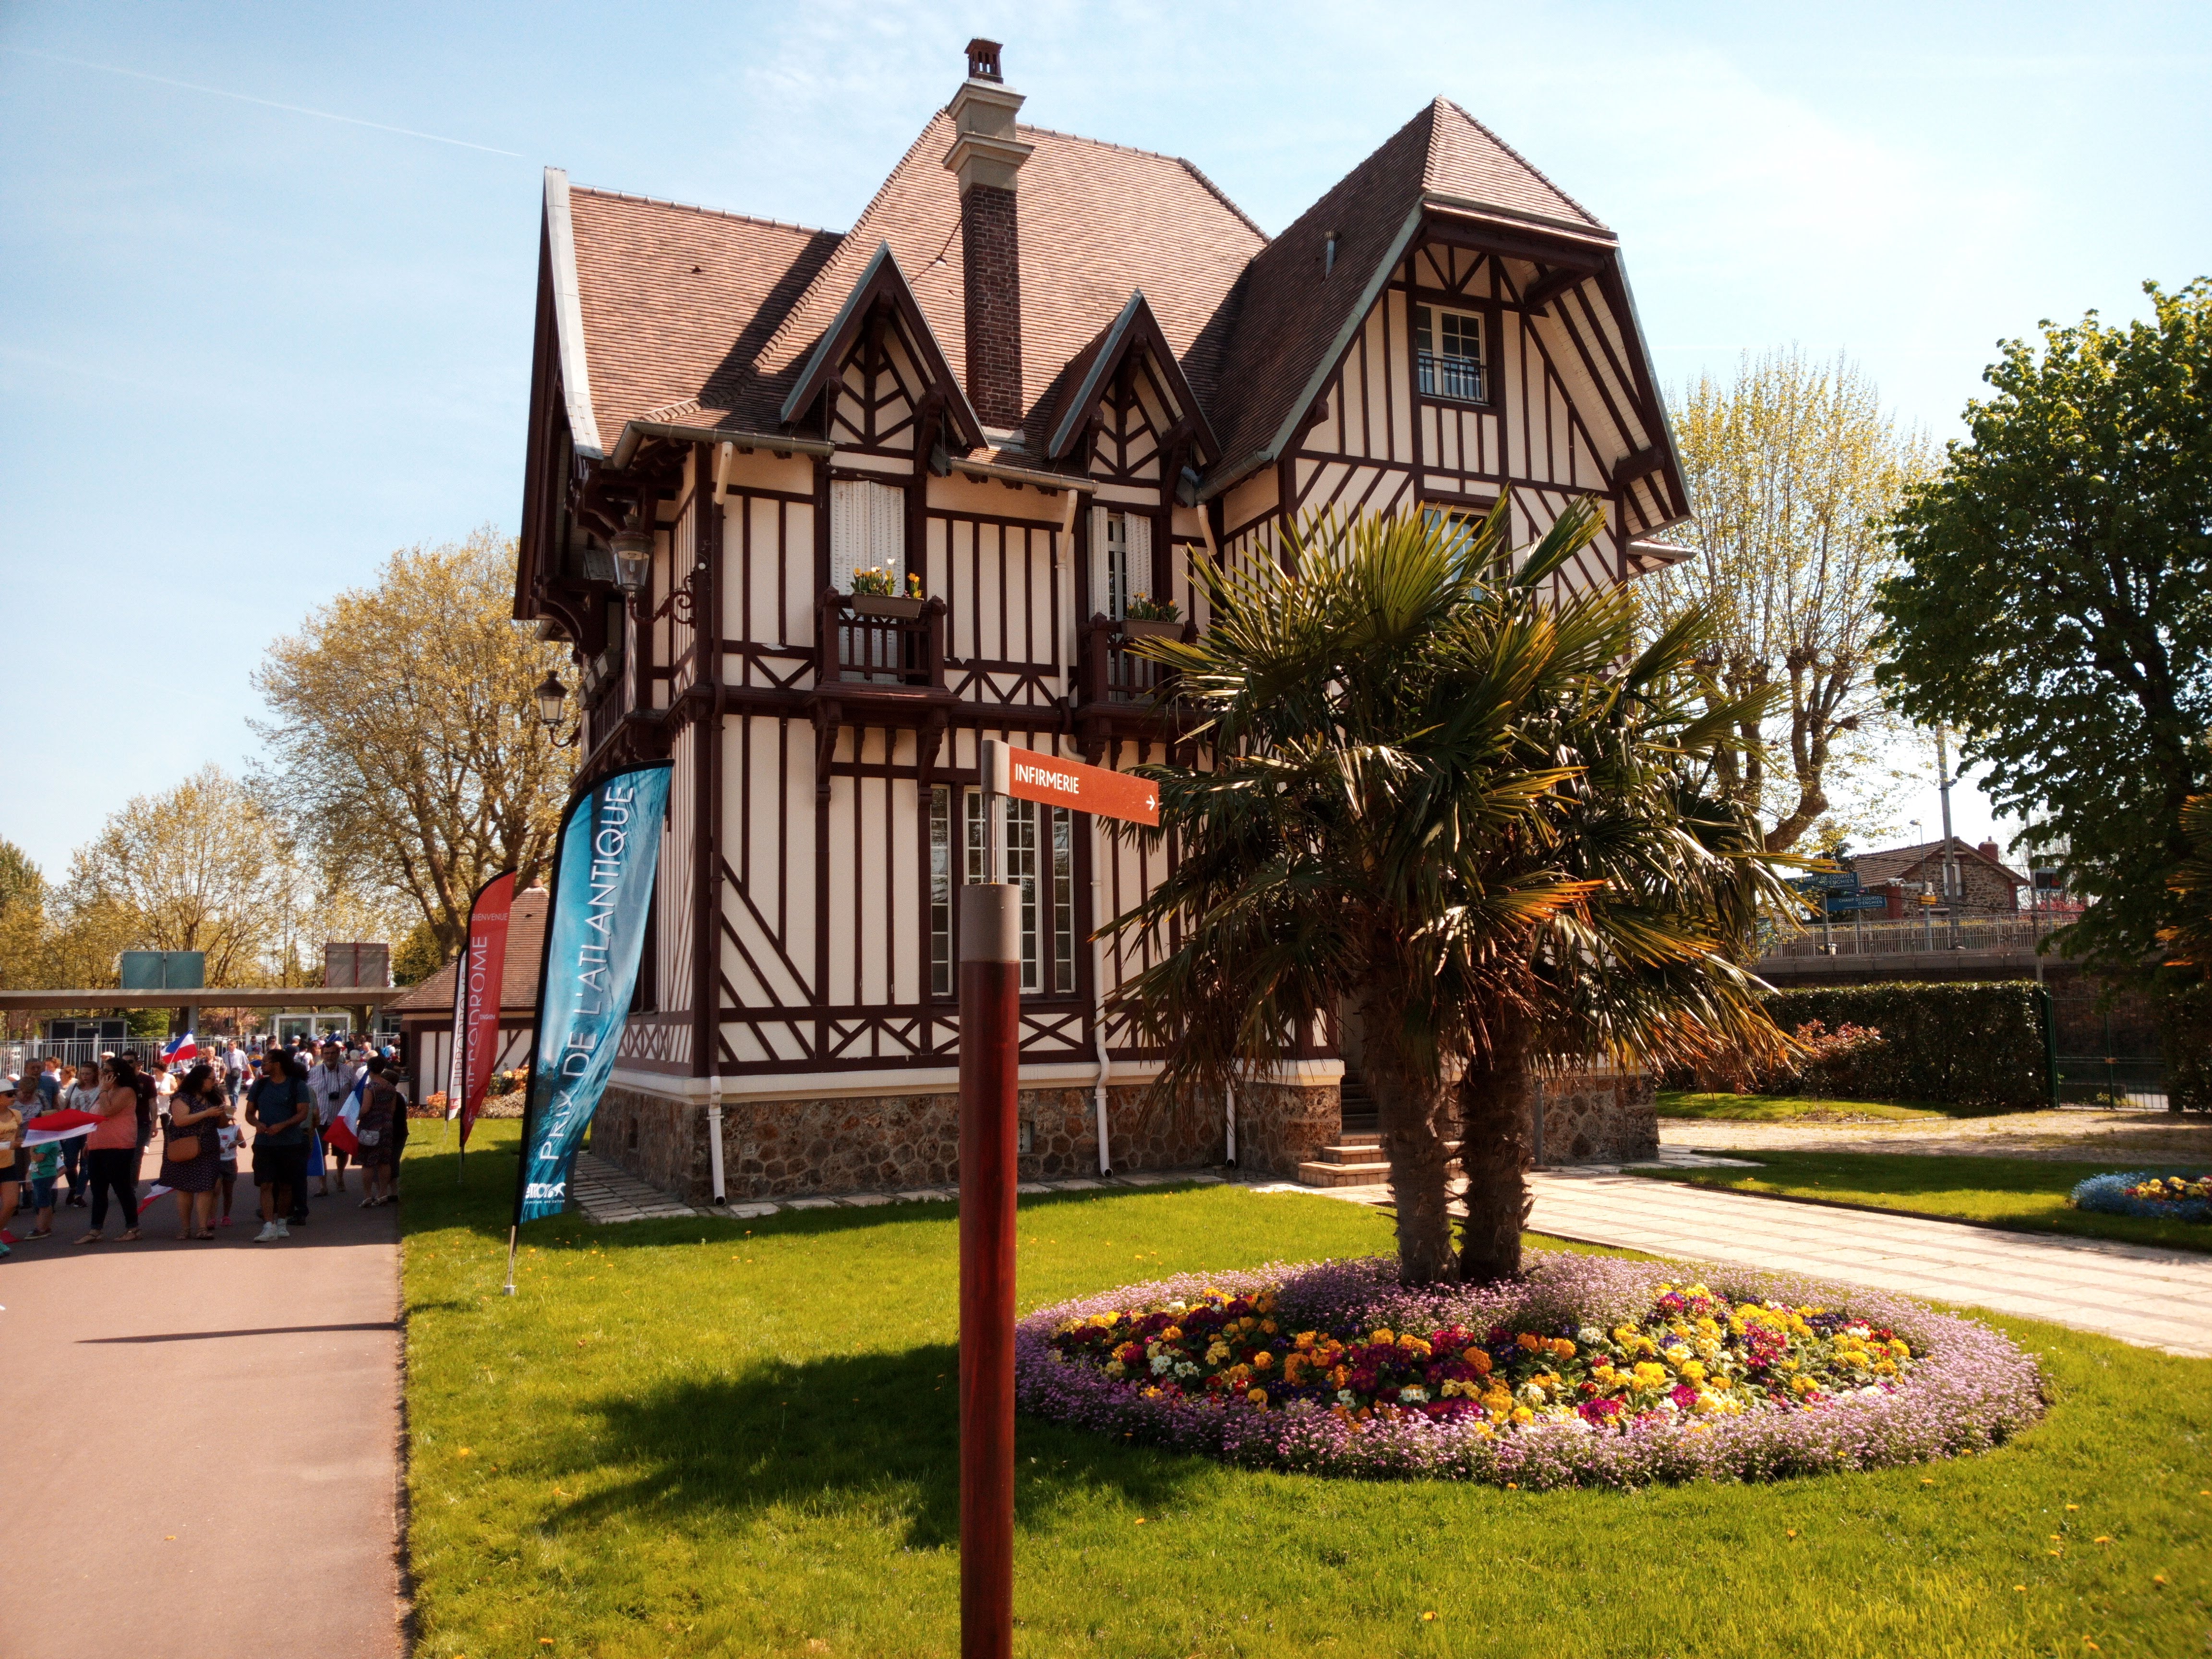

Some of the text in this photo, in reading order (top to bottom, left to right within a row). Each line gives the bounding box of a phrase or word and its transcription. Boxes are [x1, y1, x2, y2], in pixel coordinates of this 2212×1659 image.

[1016, 763, 1079, 794] INFIRMERIE
[540, 786, 634, 1160] PRIX DE L'ATLANTIQUE
